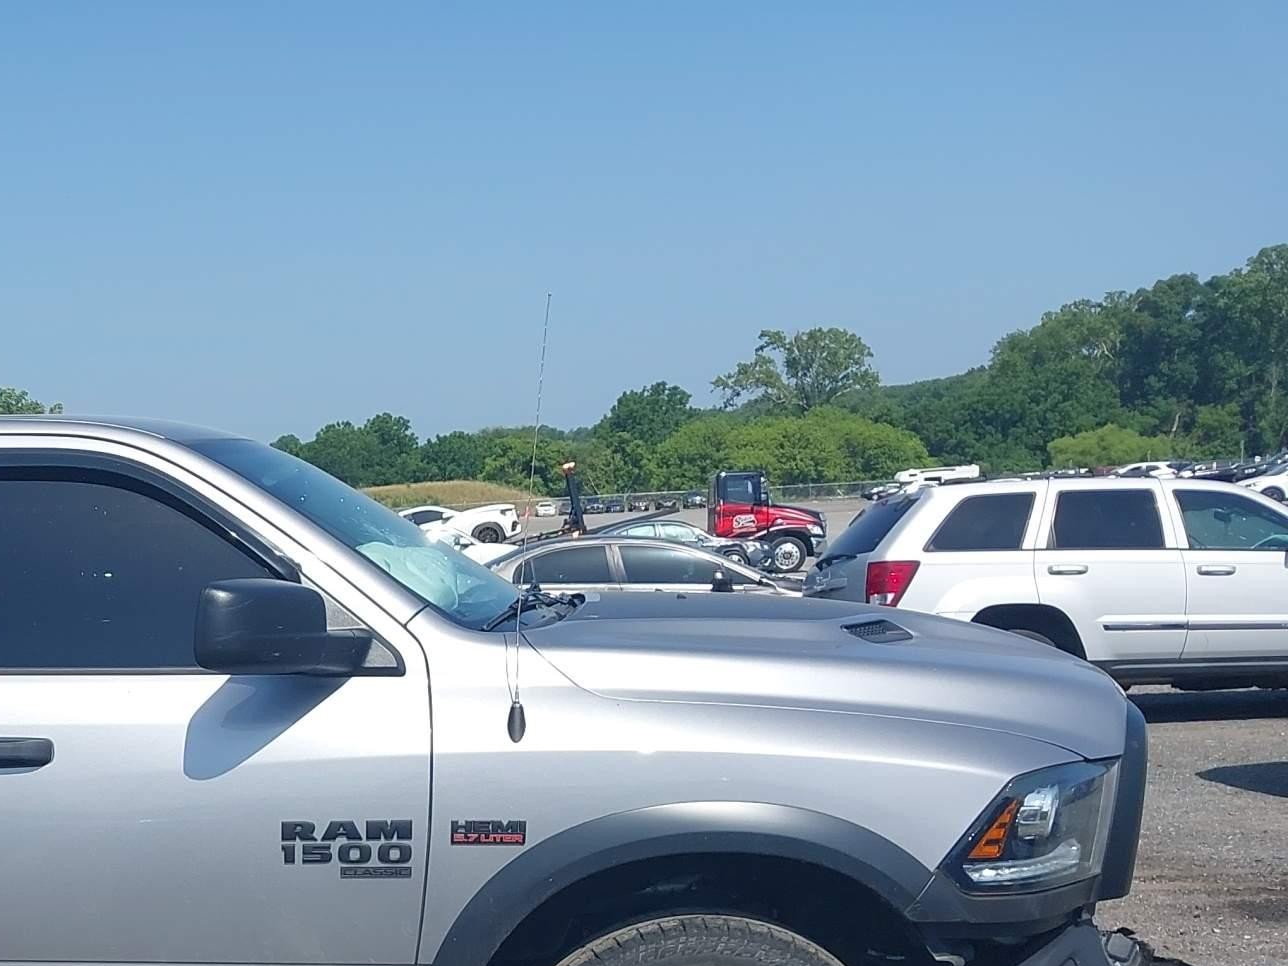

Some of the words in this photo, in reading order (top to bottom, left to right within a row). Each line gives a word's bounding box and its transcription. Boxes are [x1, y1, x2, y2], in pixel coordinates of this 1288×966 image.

[281, 820, 412, 841] RAM
[451, 821, 526, 833] HEMI
[453, 833, 478, 842] 5.7
[480, 833, 523, 843] LITER
[281, 843, 412, 865] 1500
[342, 867, 410, 877] CLASSIC
